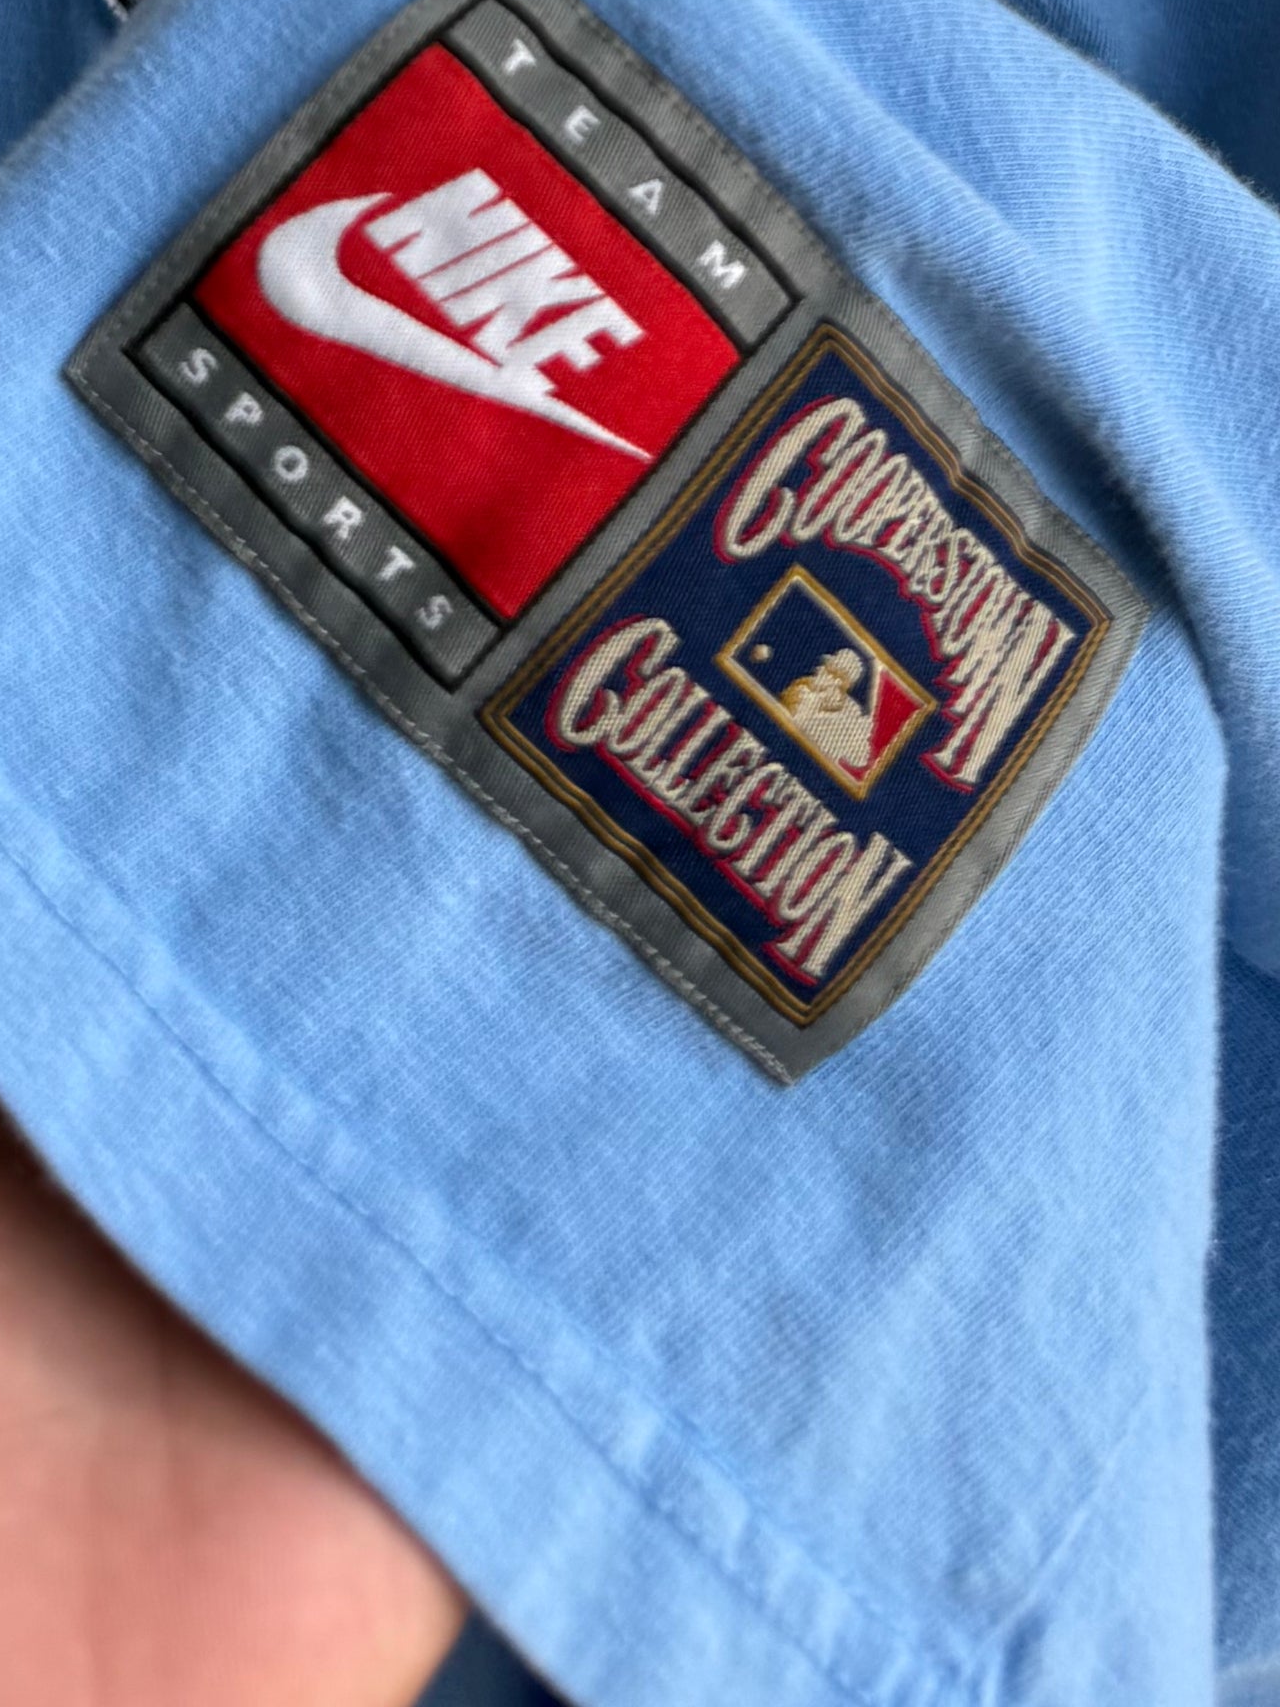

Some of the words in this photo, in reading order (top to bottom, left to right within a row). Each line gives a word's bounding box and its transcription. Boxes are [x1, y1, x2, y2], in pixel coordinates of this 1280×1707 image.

[362, 166, 645, 397] NIKE
[495, 37, 747, 290] TEAM
[178, 345, 453, 632] SPORTS
[713, 393, 1077, 791] COOPERSTOWN
[544, 614, 915, 985] COLLECTION
